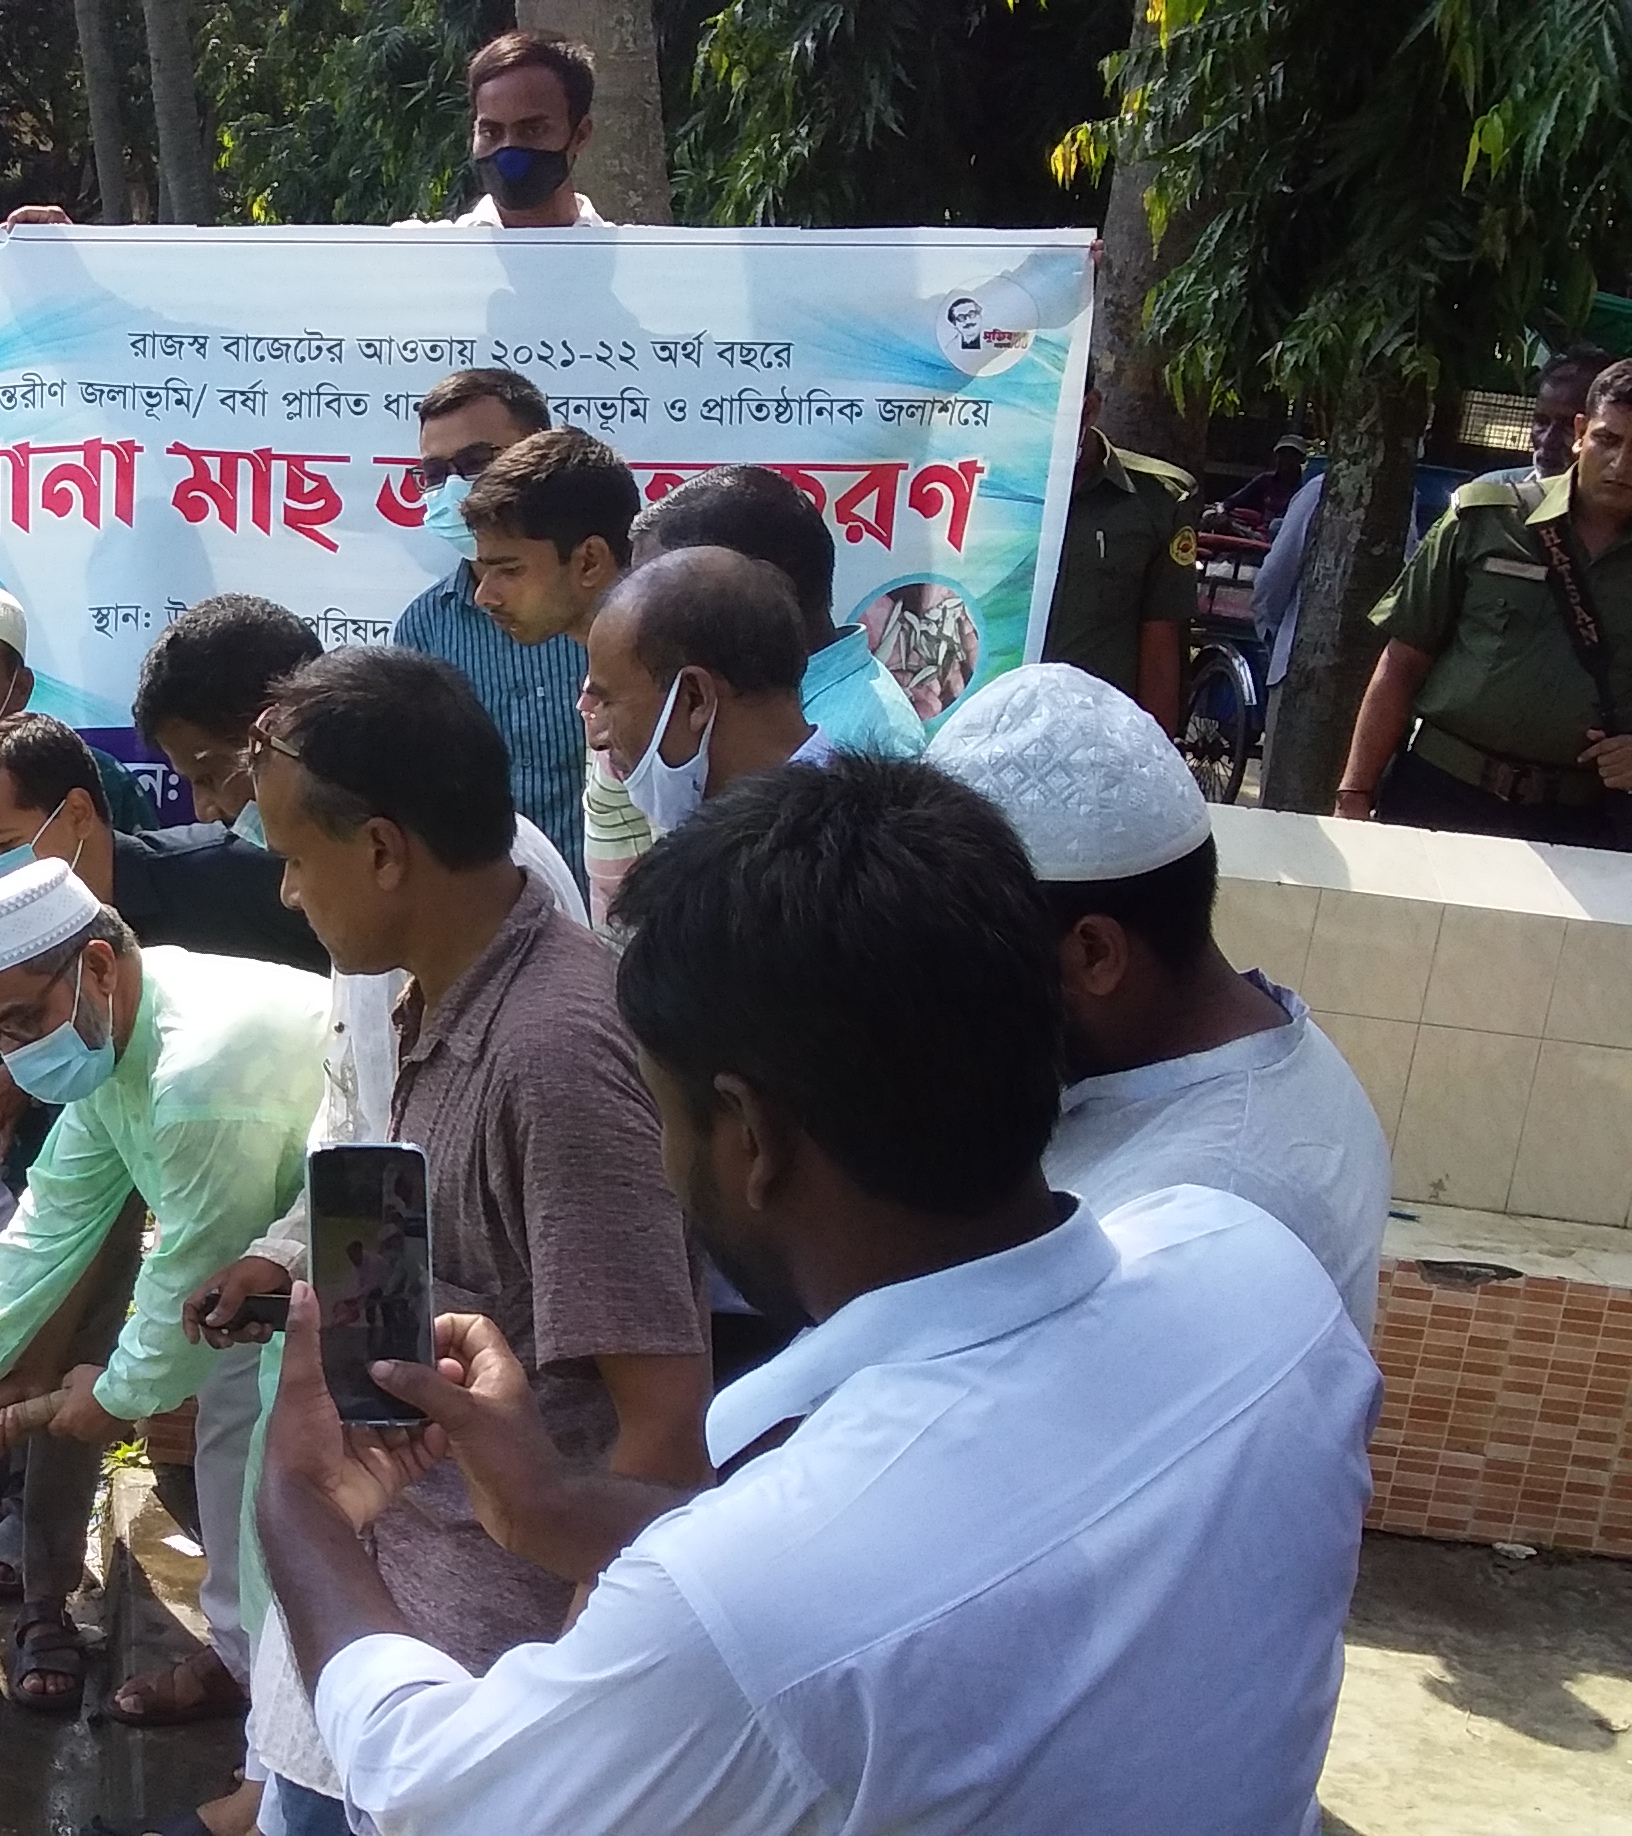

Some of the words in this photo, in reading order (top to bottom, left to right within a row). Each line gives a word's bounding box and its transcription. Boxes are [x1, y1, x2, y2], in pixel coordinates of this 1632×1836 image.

[127, 330, 210, 360] রাজস্ব
[220, 327, 346, 364] বাজেটের
[355, 335, 478, 367] আওতায়
[490, 339, 640, 371] ২০২১-২২
[649, 329, 704, 369] অর্থ
[713, 341, 795, 373] বছরে
[215, 379, 269, 417] বর্ষা
[281, 382, 371, 421] প্লাবিত
[663, 398, 687, 422] ও
[700, 386, 865, 426] প্রাতিষ্ঠানিক
[874, 396, 994, 427] জলাশয়ে
[166, 441, 351, 554] মাছ
